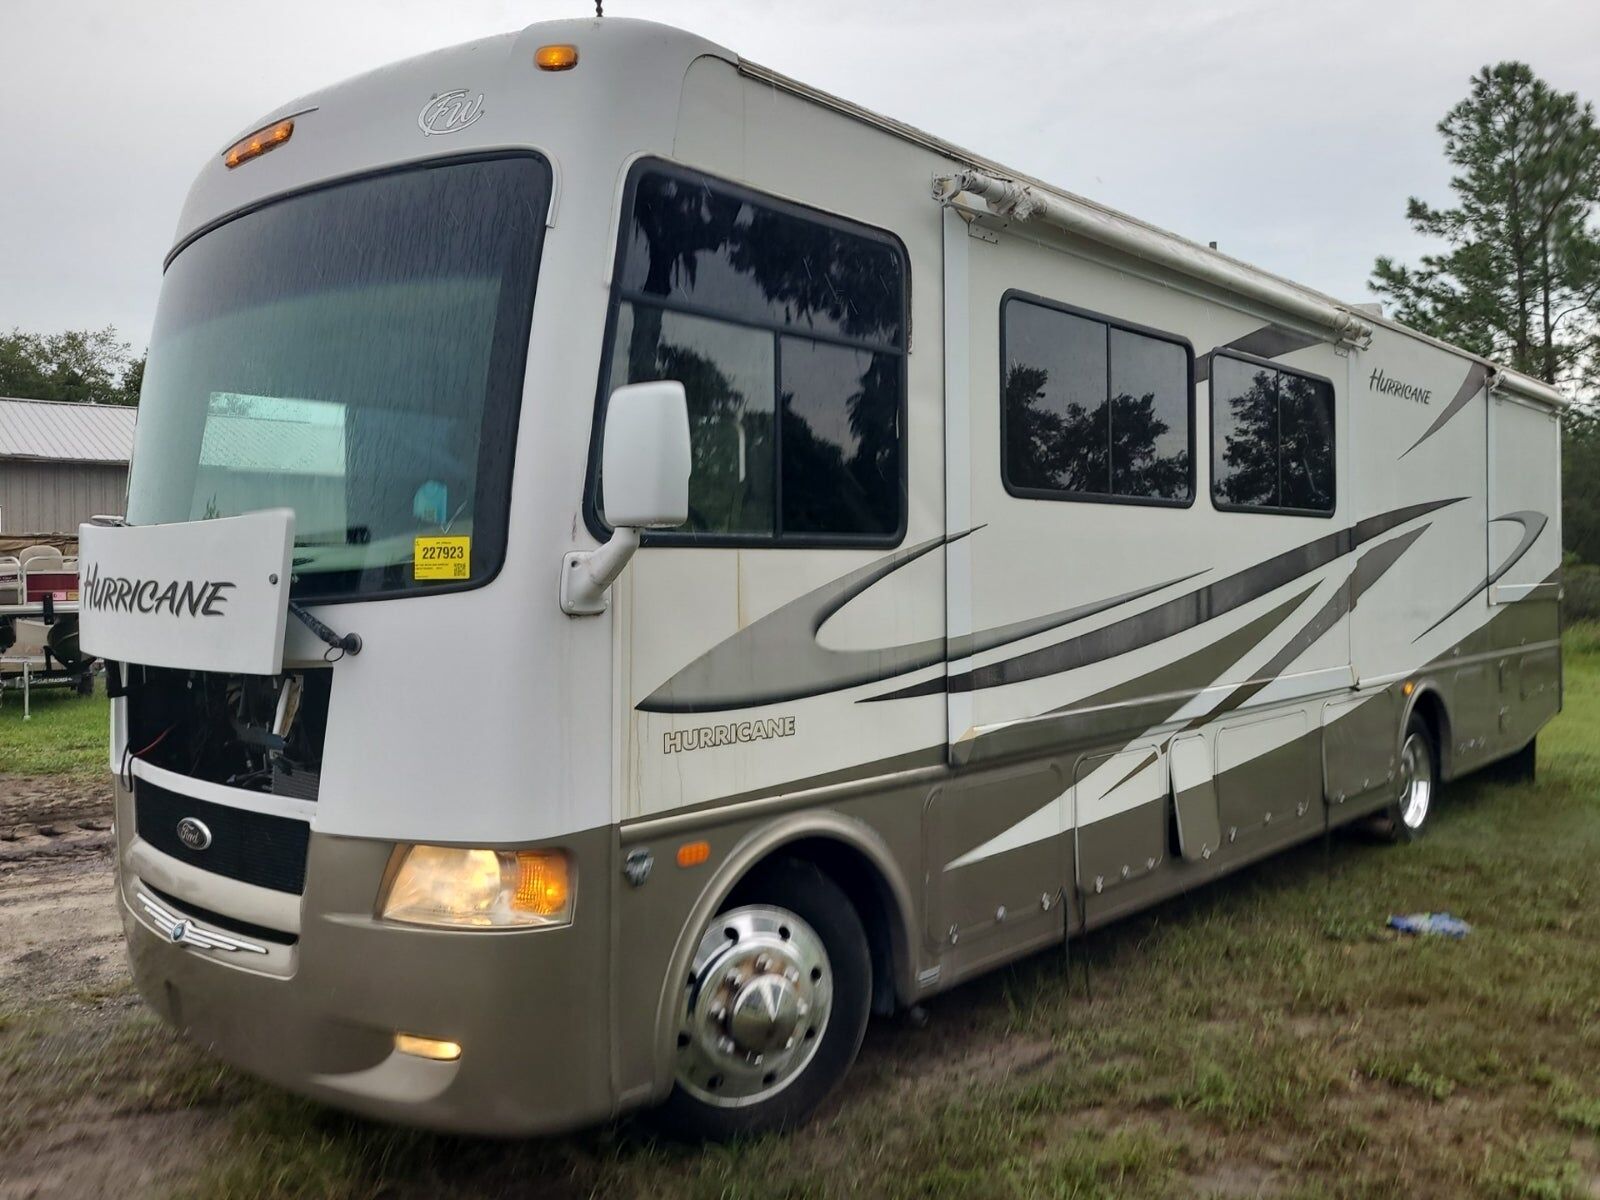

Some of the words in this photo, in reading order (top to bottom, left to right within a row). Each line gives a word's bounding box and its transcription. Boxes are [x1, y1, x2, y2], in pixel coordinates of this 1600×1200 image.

[1369, 367, 1432, 405] HURRICANE
[422, 546, 464, 560] 227923
[84, 562, 236, 618] HURRICANE
[663, 716, 796, 754] HURRICANE
